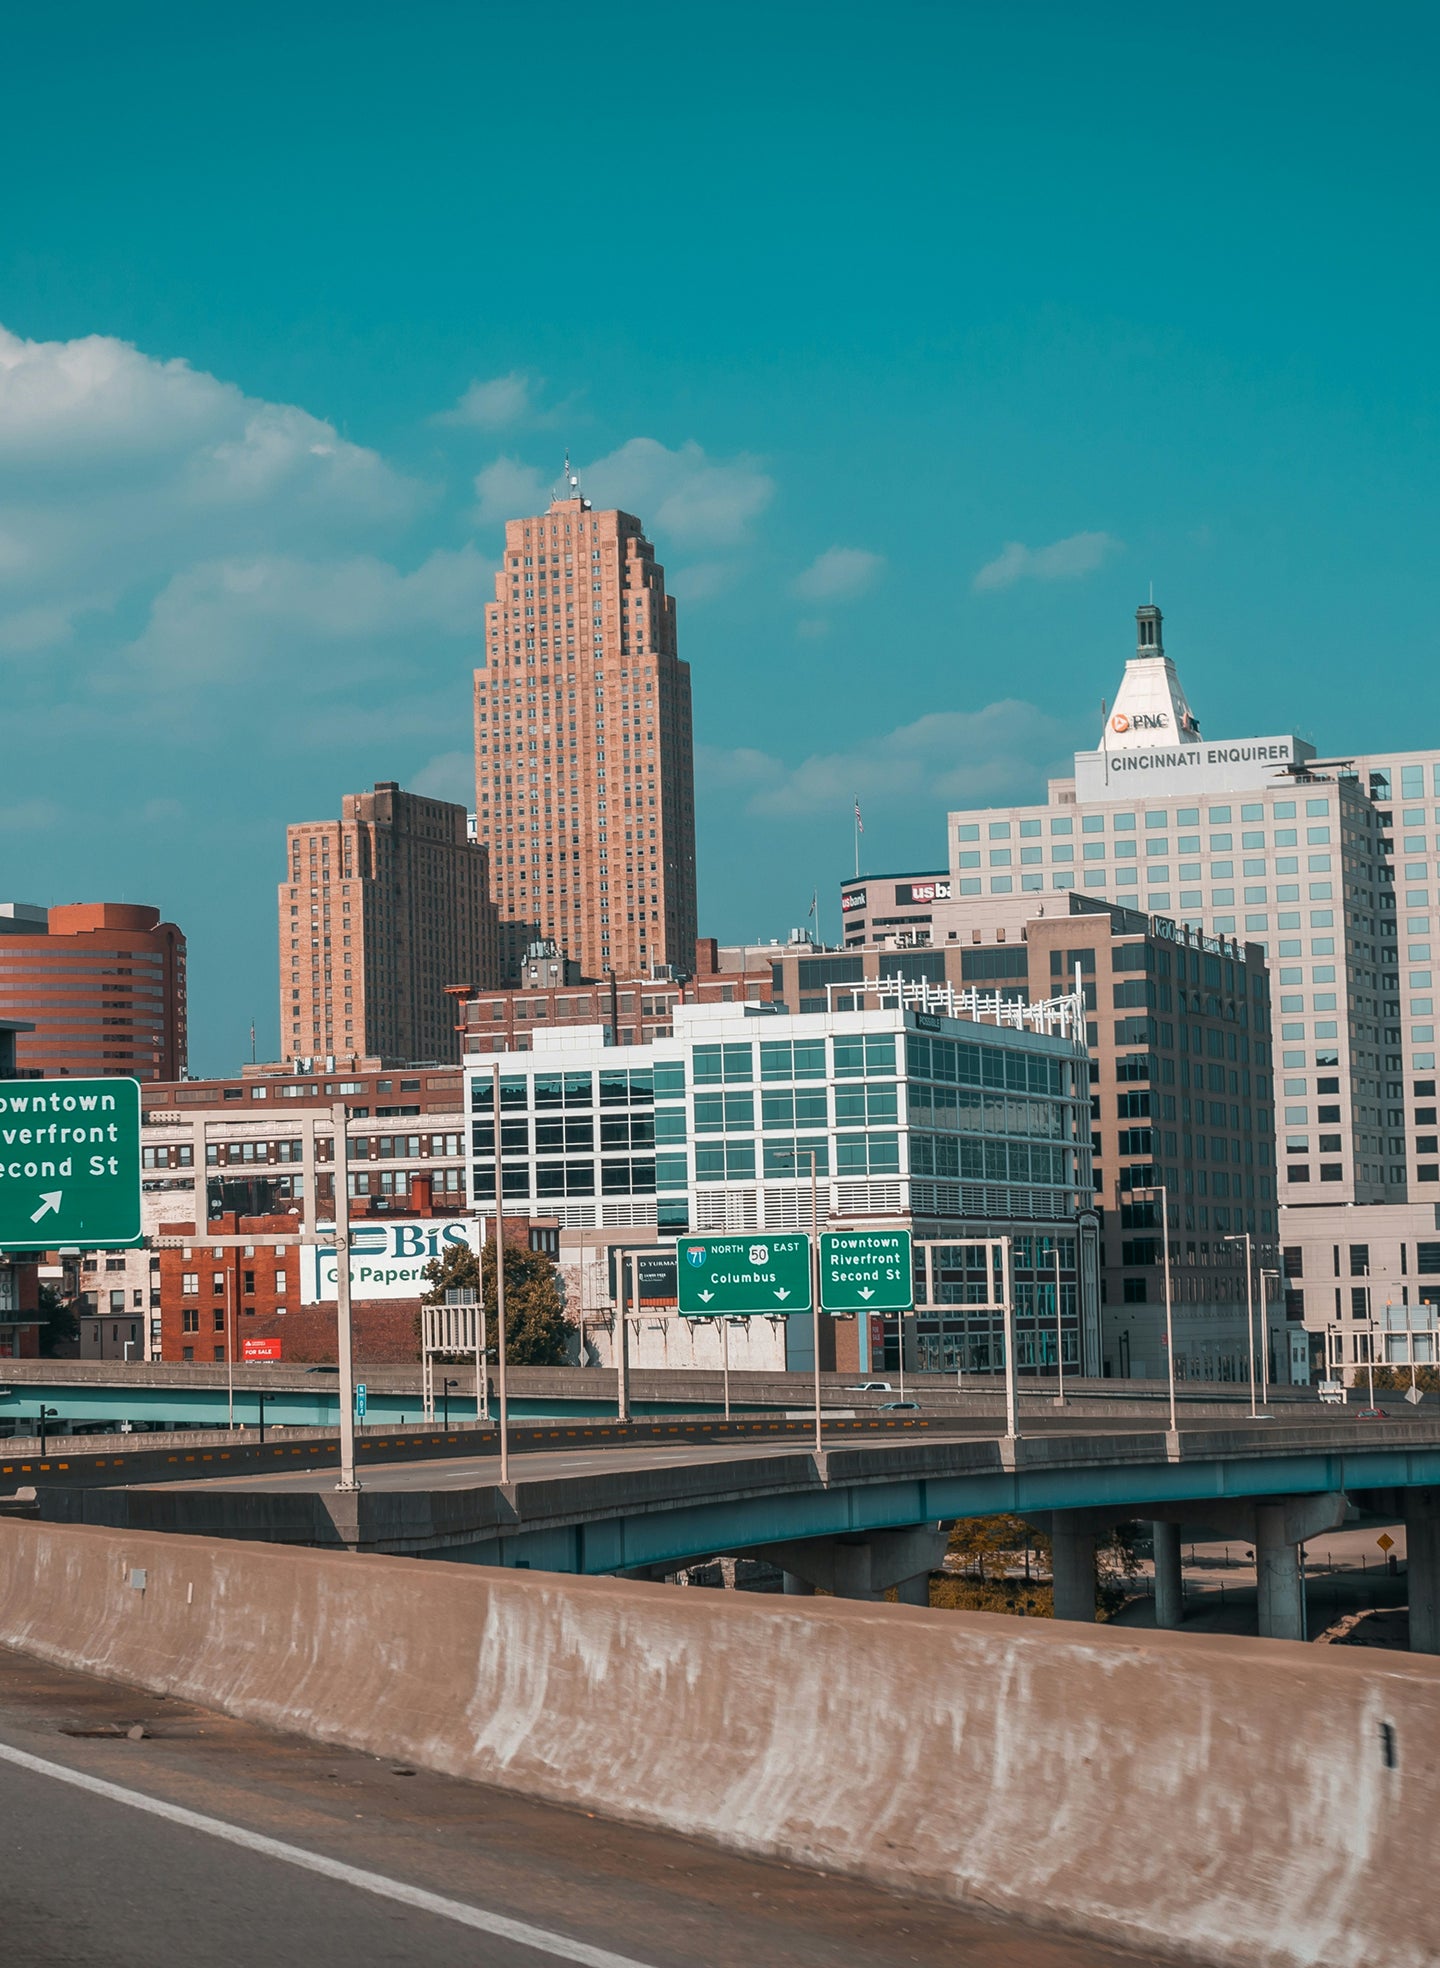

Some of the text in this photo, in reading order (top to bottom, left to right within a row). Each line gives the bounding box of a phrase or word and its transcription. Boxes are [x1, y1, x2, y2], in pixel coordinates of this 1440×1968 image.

[1132, 713, 1168, 729] PNC
[1111, 745, 1289, 771] CINCINNATI ENQUIRER
[89, 1154, 118, 1176] St
[831, 1237, 899, 1249] Downtown
[689, 1251, 702, 1263] 71
[711, 1244, 744, 1254] NORTH
[751, 1248, 767, 1261] 50
[773, 1242, 799, 1252] EAST
[830, 1253, 900, 1265] Riverfront
[711, 1272, 776, 1283] Columbus
[831, 1268, 901, 1282] Second St
